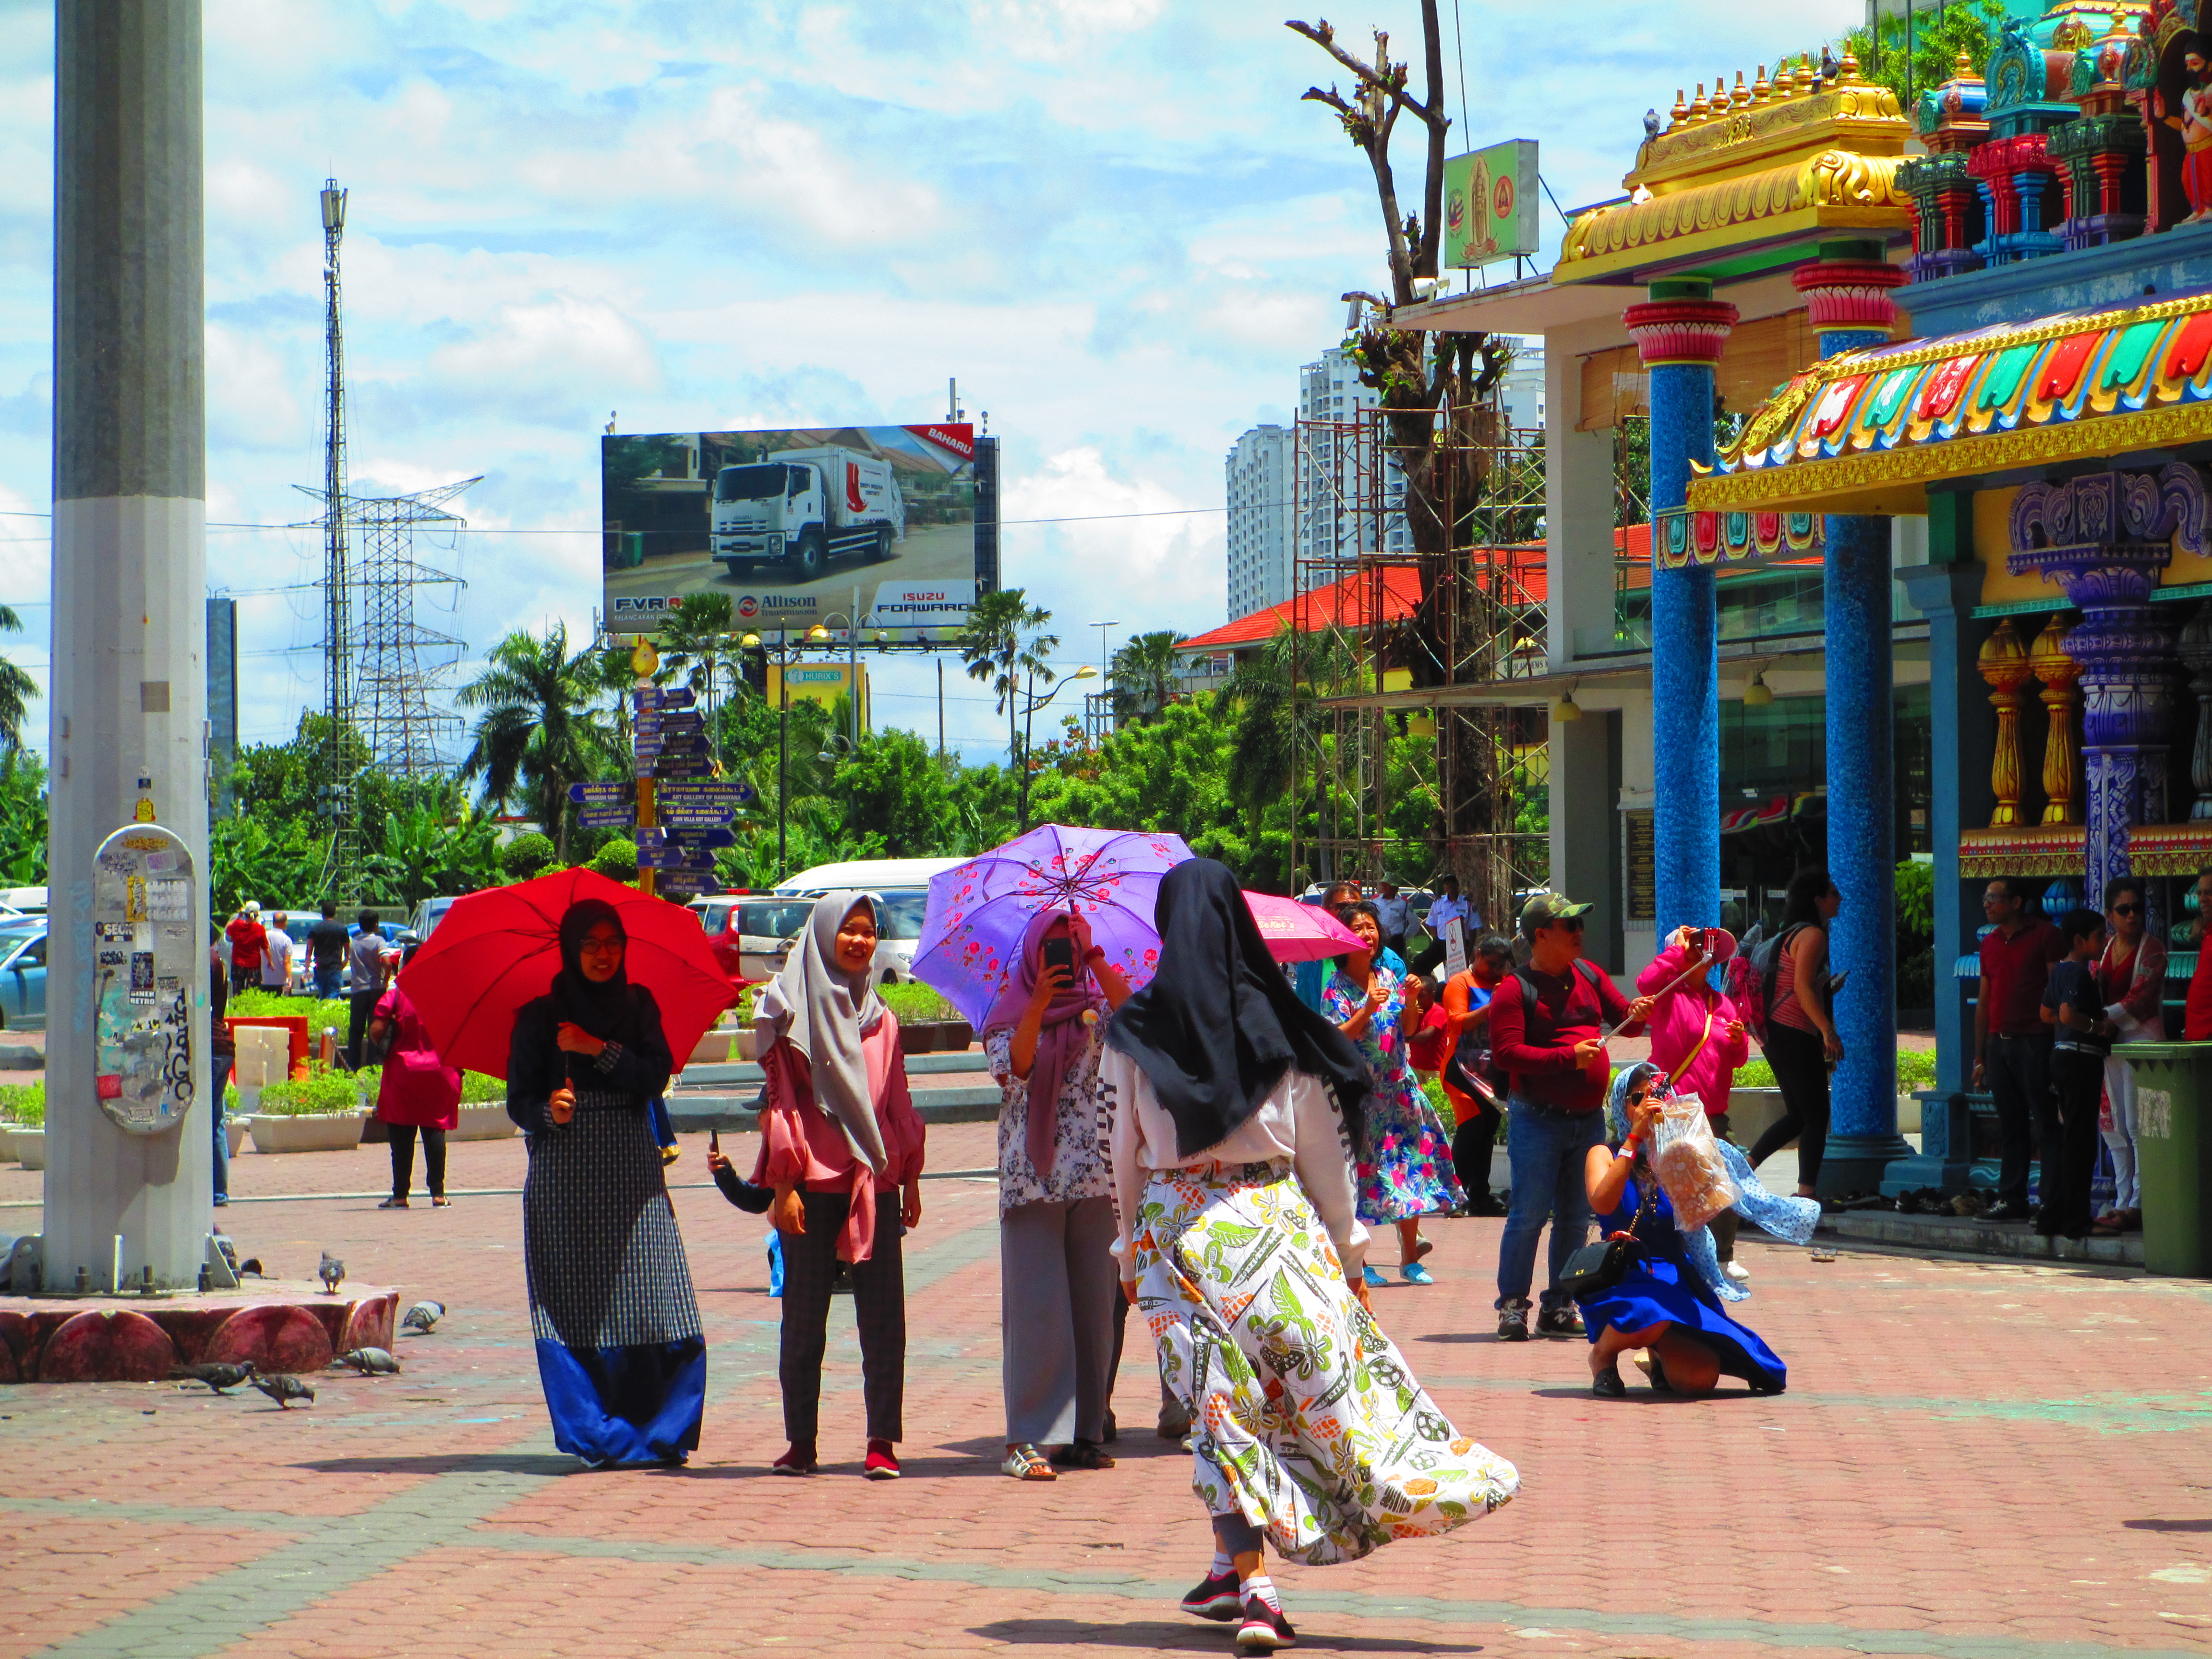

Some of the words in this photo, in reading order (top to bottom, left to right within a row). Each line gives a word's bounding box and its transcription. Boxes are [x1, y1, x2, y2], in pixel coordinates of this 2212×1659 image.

[928, 428, 972, 454] BAHARU
[762, 595, 817, 607] Allison
[903, 592, 945, 601] ISUZU
[615, 596, 665, 612] FVR
[878, 603, 968, 612] FORWARD
